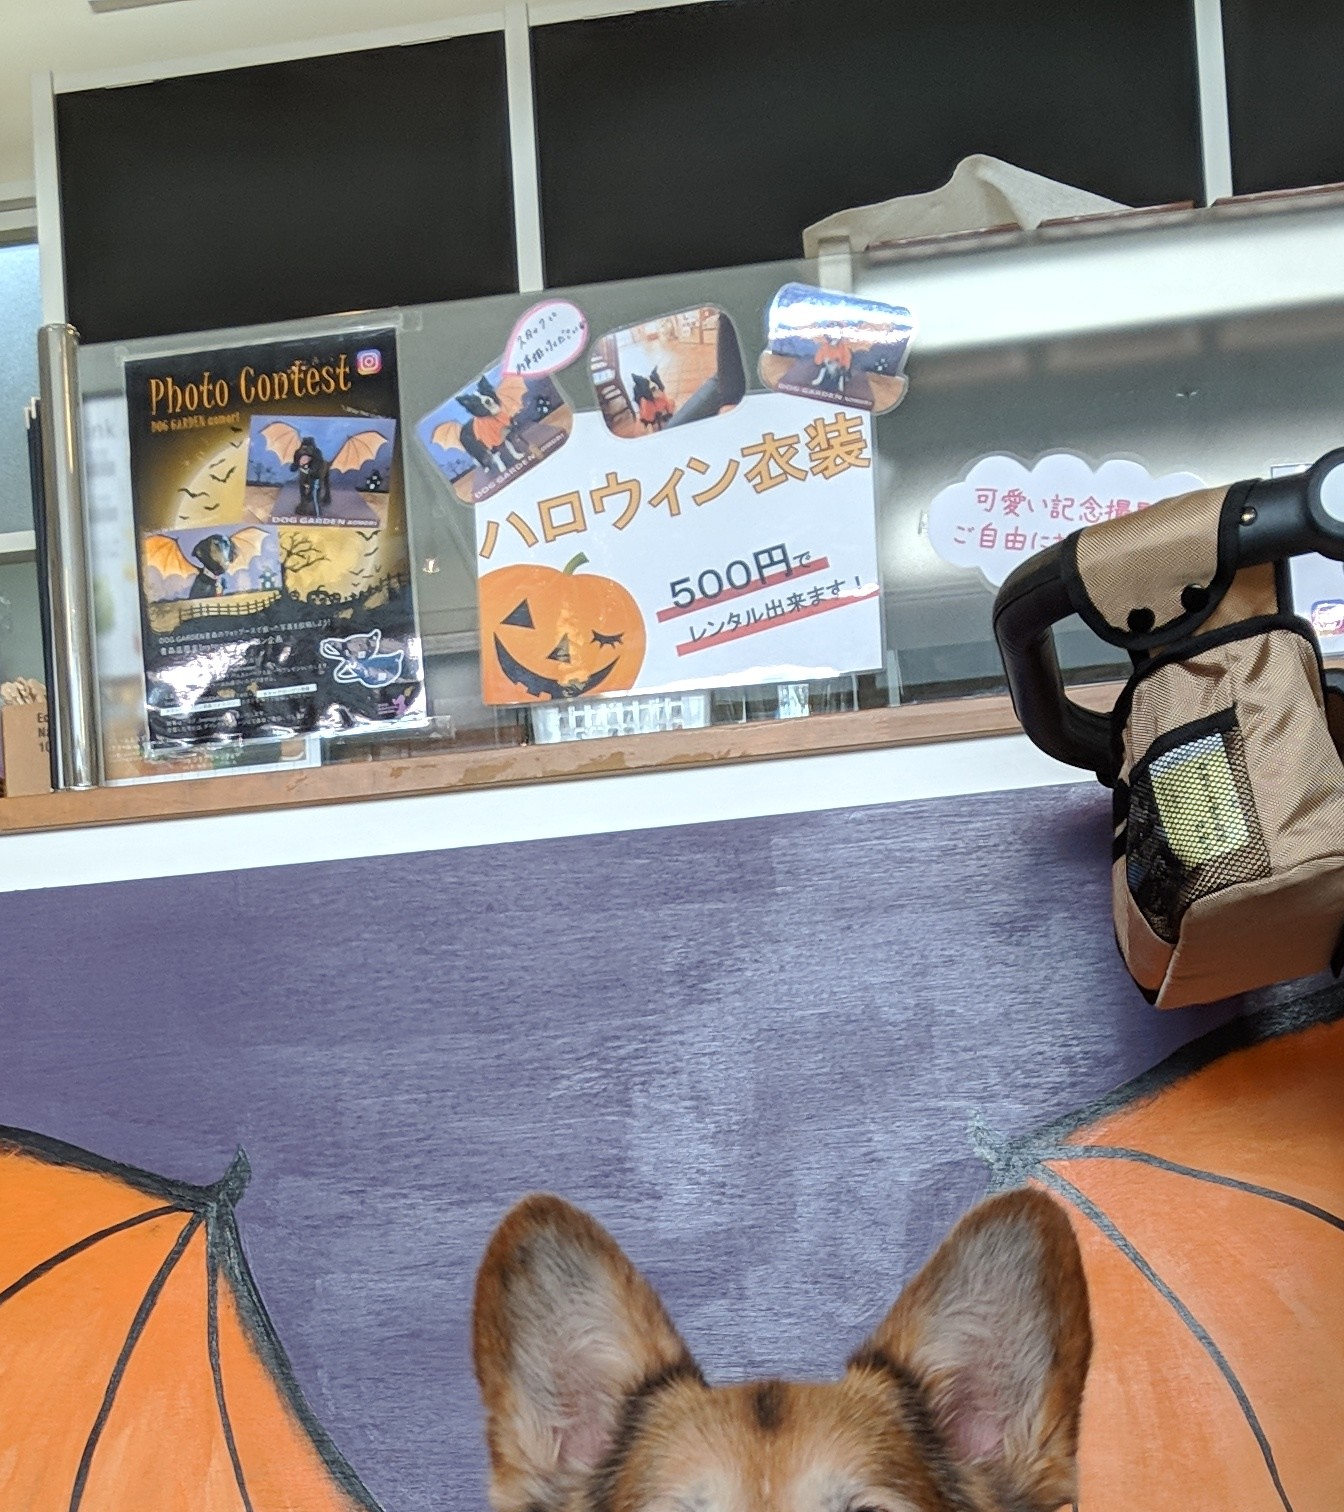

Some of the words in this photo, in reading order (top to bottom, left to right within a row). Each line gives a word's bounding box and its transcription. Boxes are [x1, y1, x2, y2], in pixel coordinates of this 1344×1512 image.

[148, 371, 230, 416] Photo
[239, 353, 353, 404] Contest
[479, 411, 873, 560] ハロウィン衣装
[271, 515, 297, 524] DOG
[669, 542, 813, 610] 500円で
